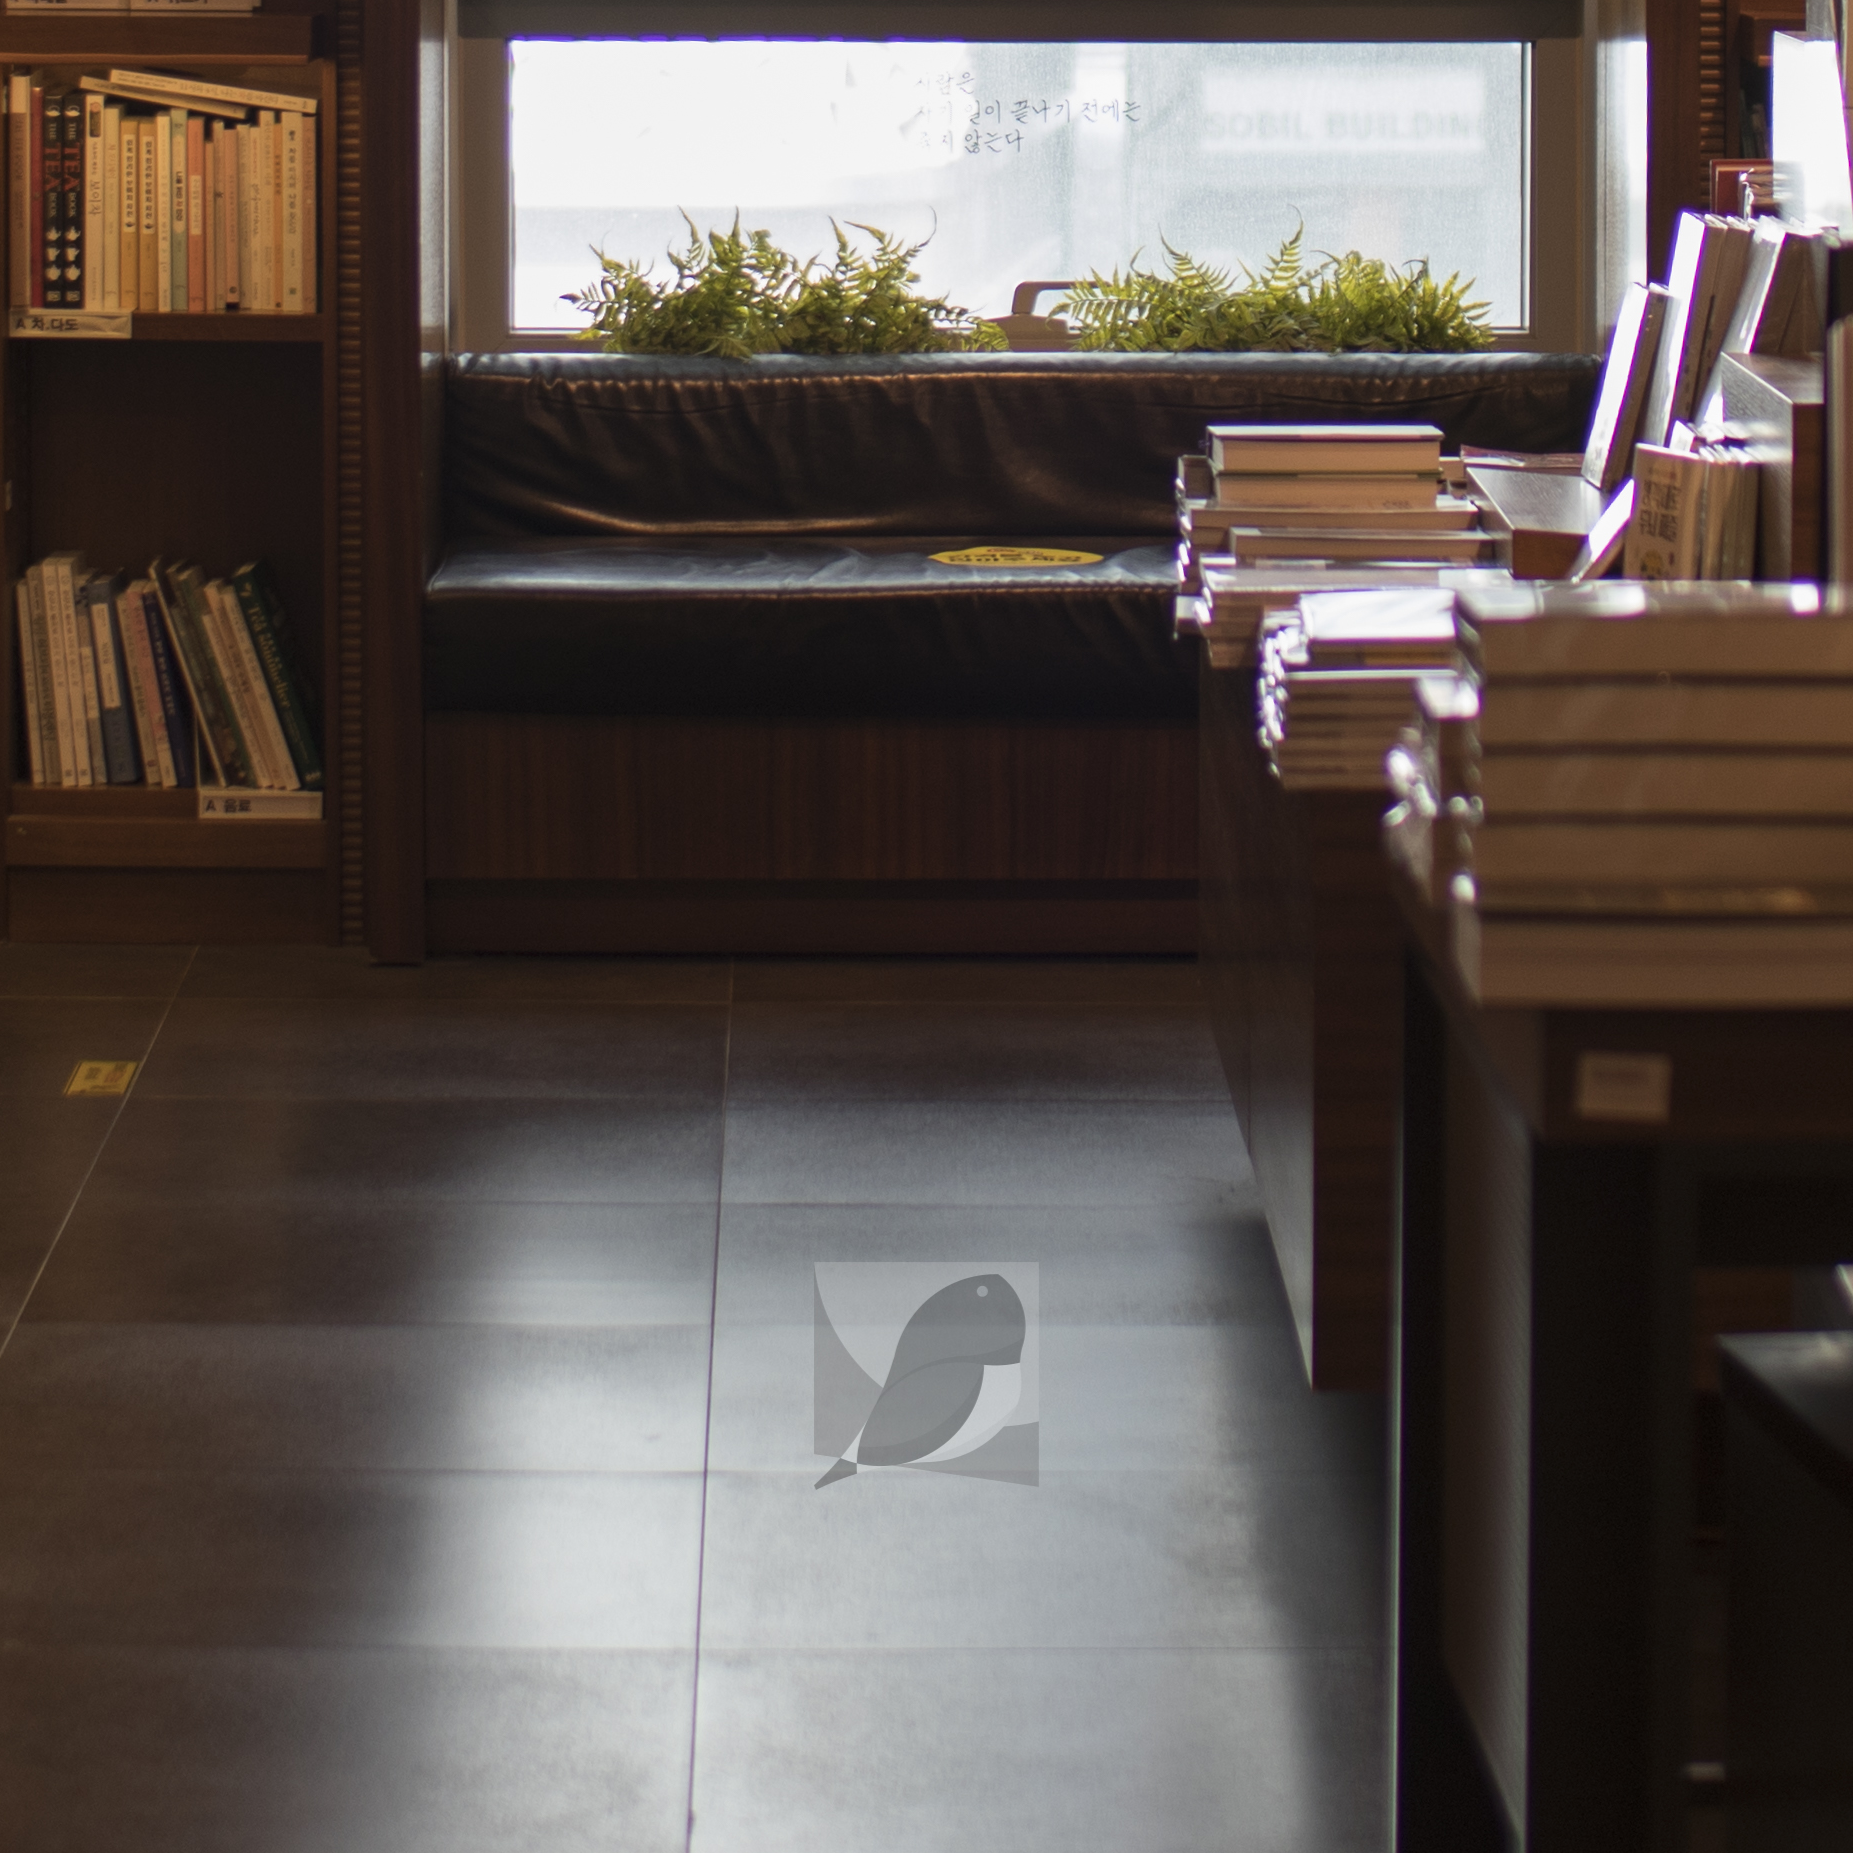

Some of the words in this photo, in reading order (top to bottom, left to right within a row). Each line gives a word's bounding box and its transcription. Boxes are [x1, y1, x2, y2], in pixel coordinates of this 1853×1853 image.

[965, 99, 1001, 126] 일이
[1010, 99, 1071, 125] 끝나기
[1082, 99, 1141, 123] 전에는
[1325, 110, 1484, 140] BUILDIN
[48, 122, 57, 140] THE
[67, 122, 78, 140] THE
[964, 128, 1024, 154] 않는다
[44, 142, 61, 191] TEA
[63, 142, 80, 191] TEA
[48, 194, 57, 218] BOOK
[67, 194, 77, 218] BOOK
[89, 180, 101, 216] 보이차
[15, 317, 26, 330] A
[205, 800, 216, 812] A
[223, 799, 252, 813] 음료
